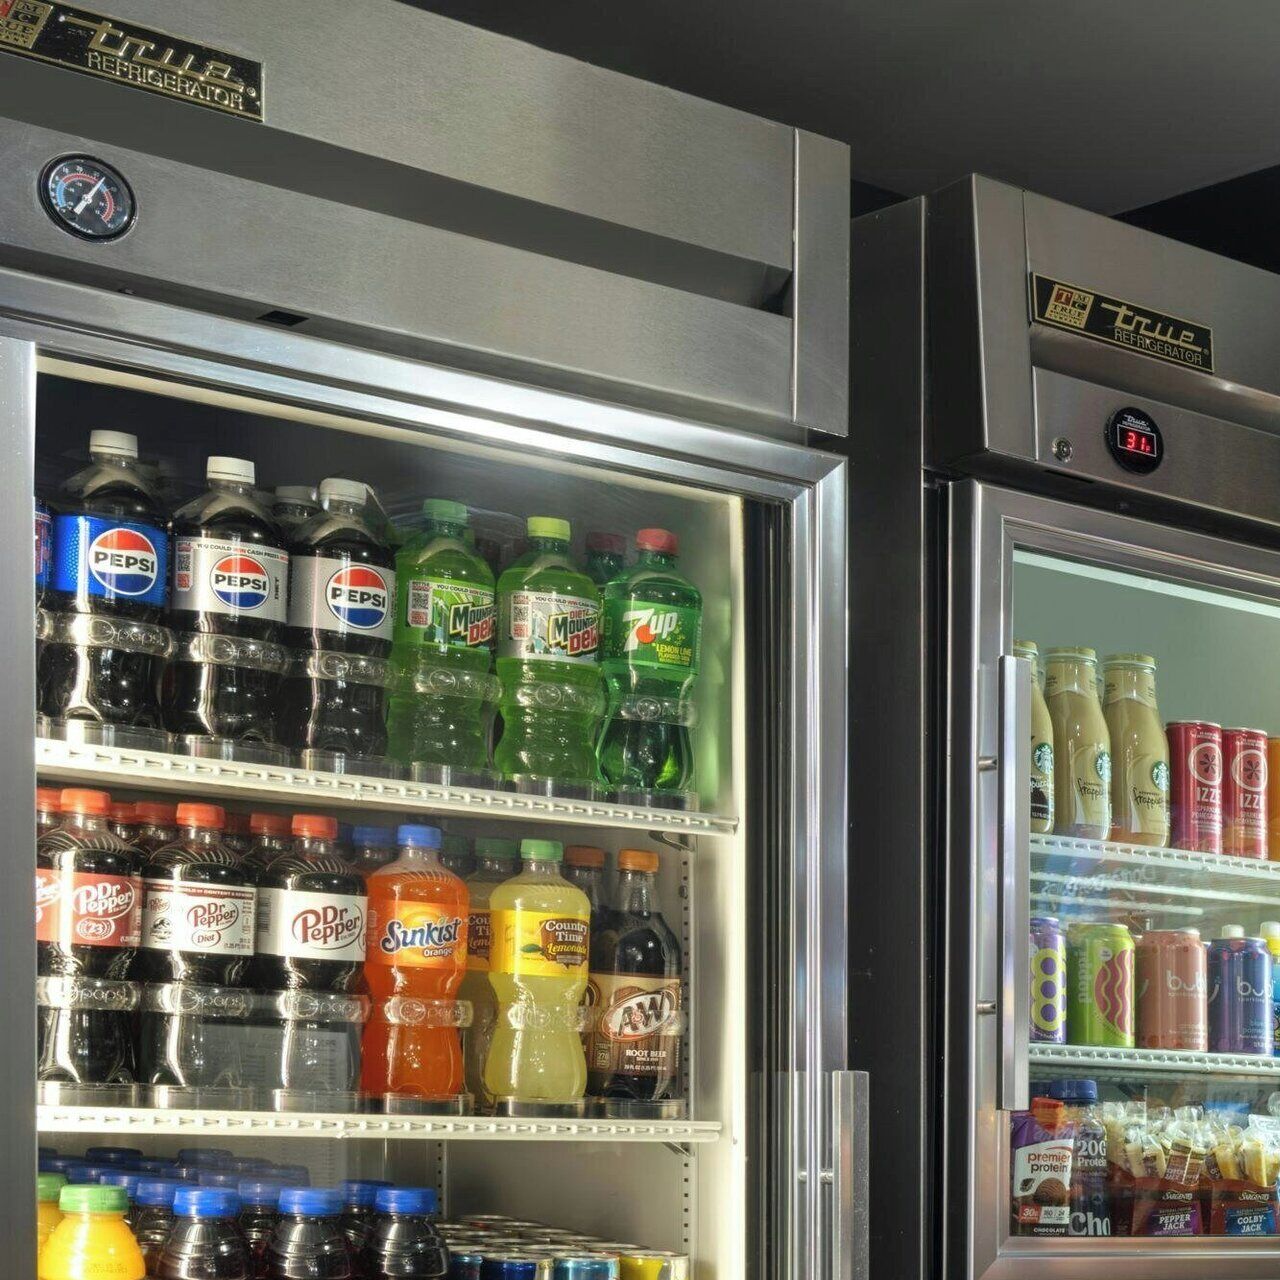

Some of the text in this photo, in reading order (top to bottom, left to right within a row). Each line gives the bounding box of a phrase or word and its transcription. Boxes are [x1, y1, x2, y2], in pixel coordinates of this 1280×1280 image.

[87, 51, 243, 109] REFRIGERATOR
[1114, 328, 1202, 365] REFRIGERATOR
[94, 550, 154, 574] PEPSI
[214, 574, 267, 592] PEPSI
[331, 586, 386, 608] PEPSI
[98, 882, 121, 900] Dr
[77, 886, 132, 914] Pepper
[190, 904, 237, 926] Pepper
[207, 903, 225, 916] Dr
[323, 906, 348, 923] Dr
[300, 910, 360, 944] Pepper
[381, 916, 463, 953] Sunkist
[546, 920, 588, 935] Country
[197, 933, 215, 944] Diet
[556, 931, 583, 943] Time
[423, 947, 454, 958] Orange
[1031, 1162, 1068, 1174] protein
[1159, 1213, 1191, 1224] PEPPER
[1162, 1221, 1185, 1230] JACK
[1240, 1223, 1261, 1233] JACK
